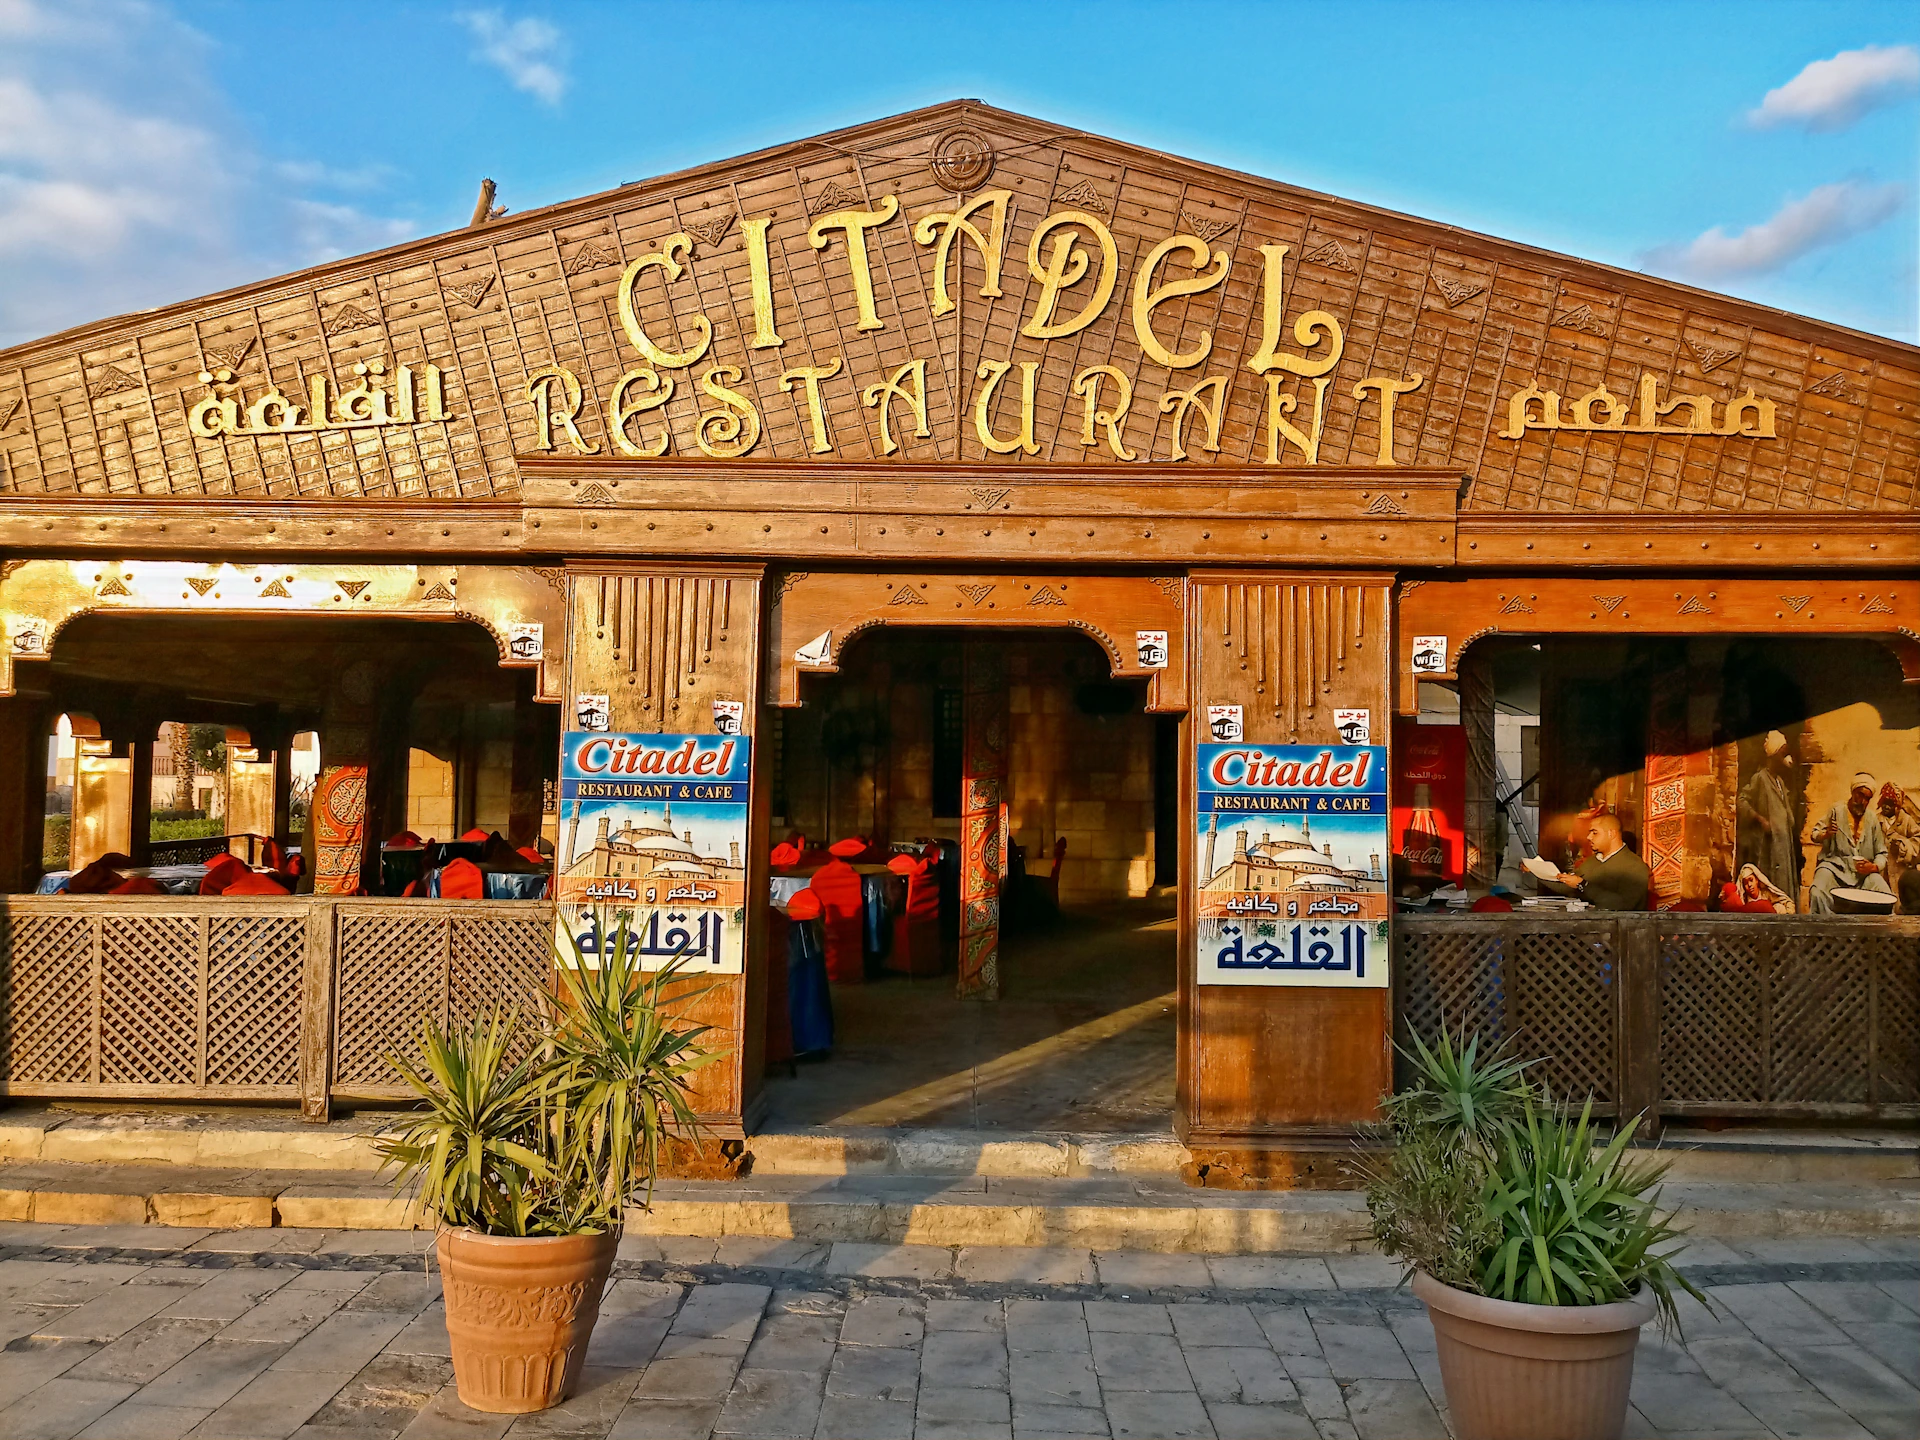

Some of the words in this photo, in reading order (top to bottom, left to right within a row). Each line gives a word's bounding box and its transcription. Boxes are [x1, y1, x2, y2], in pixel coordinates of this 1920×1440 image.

[617, 190, 1343, 378] CITADEL
[188, 363, 453, 438] القلعة
[524, 356, 1424, 466] RESTAURANT
[1497, 373, 1778, 440] مطعم
[1210, 707, 1238, 718] يوجد
[1338, 711, 1367, 721] يوجد
[577, 738, 735, 776] Citadel
[1212, 751, 1371, 787] Citadel
[577, 783, 673, 798] RESTAURANT
[678, 787, 691, 799] &
[694, 786, 733, 799] CAFE
[1213, 795, 1310, 811] RESTAURANT
[1316, 797, 1329, 811] &
[1331, 797, 1371, 811] CAFE
[585, 880, 638, 900] كافيه
[645, 887, 657, 902] و
[665, 882, 718, 902] مطعم
[1226, 894, 1279, 915] كافيه
[1287, 901, 1298, 916] و
[1306, 894, 1360, 915] مطعم
[575, 910, 725, 965] القلعة
[1217, 924, 1368, 978] القلعة
